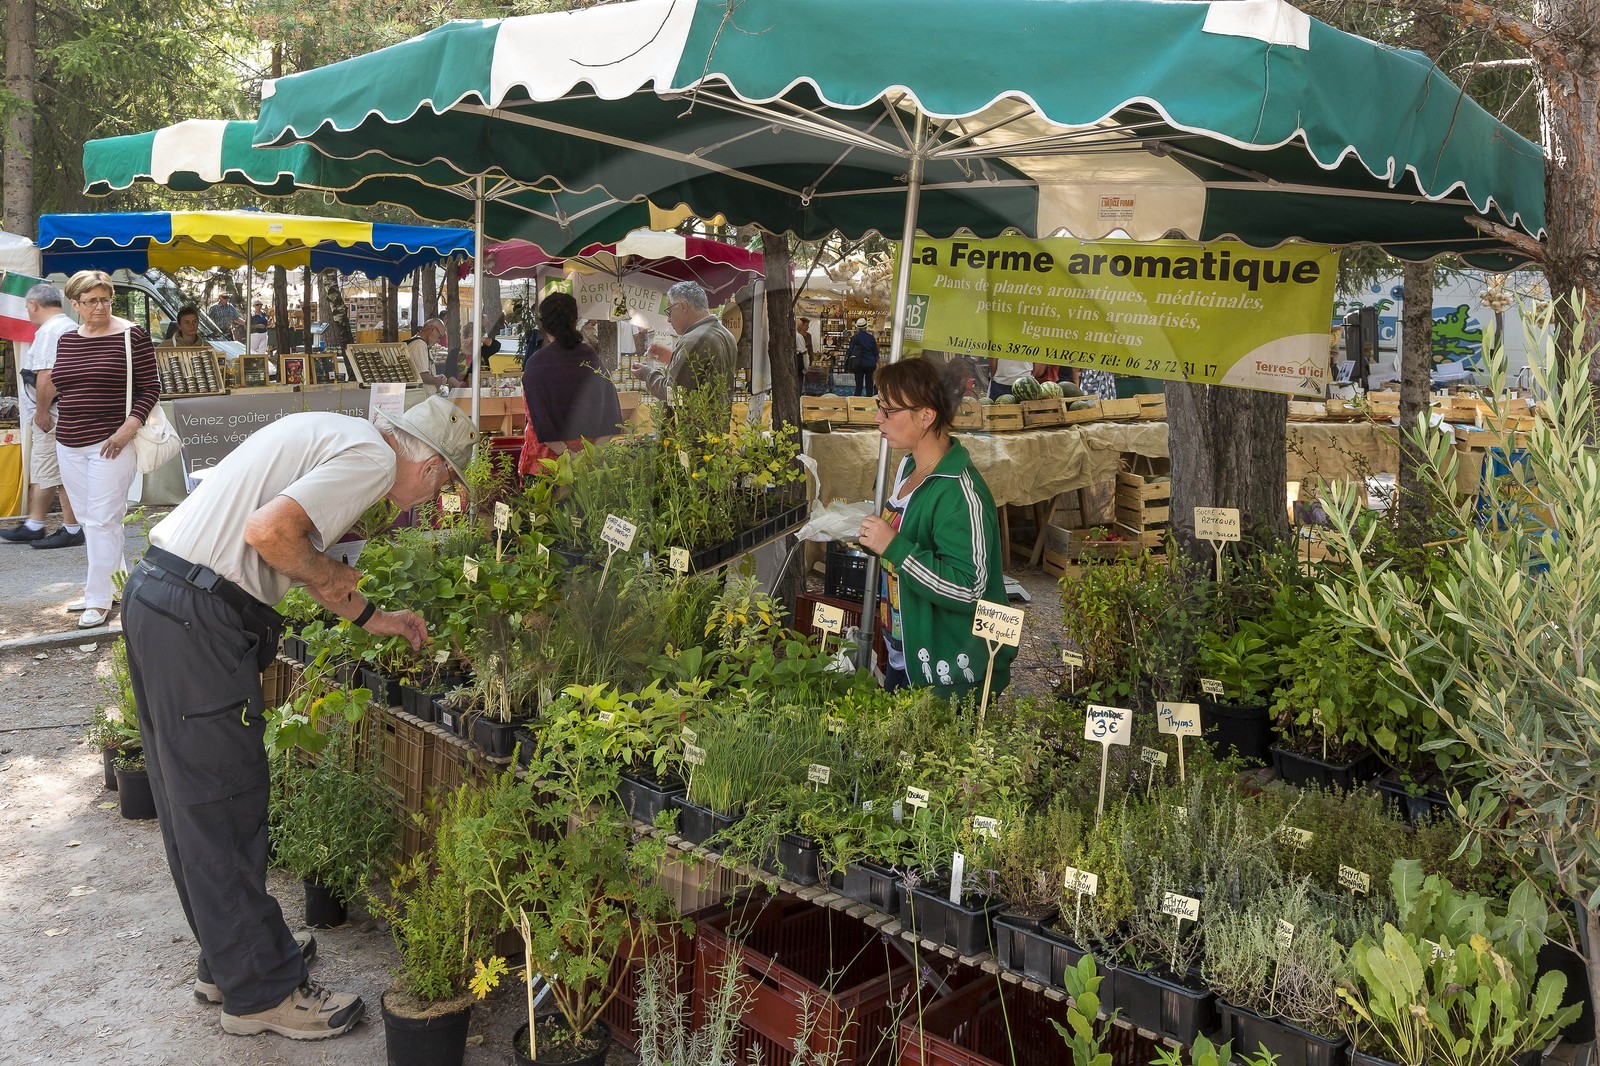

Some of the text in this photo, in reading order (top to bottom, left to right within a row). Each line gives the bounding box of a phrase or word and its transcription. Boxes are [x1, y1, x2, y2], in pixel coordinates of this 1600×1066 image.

[950, 242, 1054, 272] Ferme
[1067, 250, 1321, 291] aromatique
[933, 274, 1265, 312] Plants de plantes aromatiques, médicinales,
[975, 299, 1201, 334] petits fruits, vins aromatisés,
[1021, 320, 1144, 349] légumes anciens
[946, 336, 1218, 379] Malissoles 38760 VARCES Tél: 06 28 72 31 17
[1256, 361, 1324, 379] Terres d'ici
[182, 413, 224, 427] Venez
[229, 411, 270, 428] goûter
[183, 432, 218, 447] pâtés
[977, 604, 1020, 626] AROMATIQUES
[1159, 705, 1172, 717] Les
[1164, 716, 1194, 732] Thyms
[1166, 896, 1188, 909] THYM
